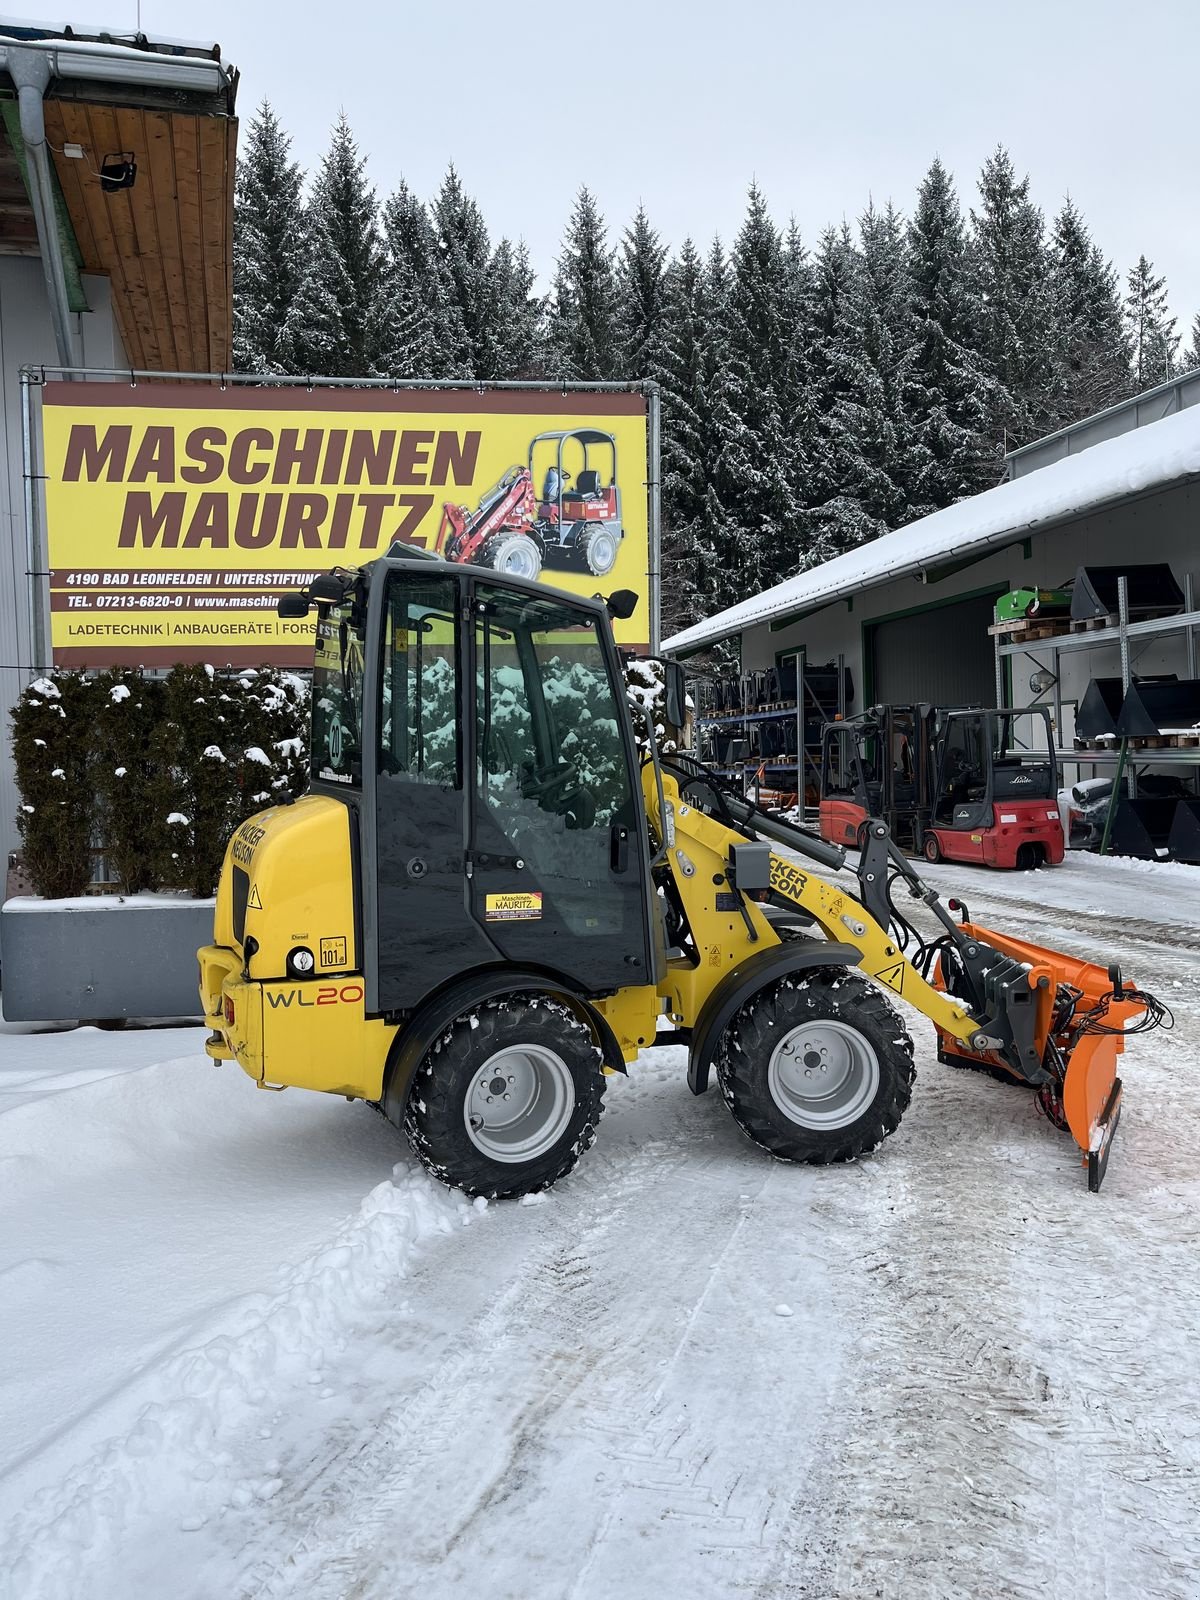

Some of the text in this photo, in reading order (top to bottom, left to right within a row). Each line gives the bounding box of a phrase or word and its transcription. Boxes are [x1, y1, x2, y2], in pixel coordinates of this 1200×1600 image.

[62, 424, 482, 486] MASCHINEN
[117, 491, 435, 549] MAURITZ
[66, 573, 99, 585] 4190
[102, 573, 129, 585] BAD
[132, 573, 212, 585] LEONFELDEN
[68, 595, 92, 607] TEL.
[96, 595, 183, 607] 07213-6820-0
[68, 624, 163, 635] LADETECHNIK
[173, 622, 272, 635] ANBAUGERÄTE
[1009, 775, 1033, 784] Linde
[769, 857, 808, 888] CKER
[769, 871, 803, 899] SON
[495, 900, 532, 909] MAURITZ
[323, 949, 338, 964] 101
[266, 985, 363, 1009] WL20
